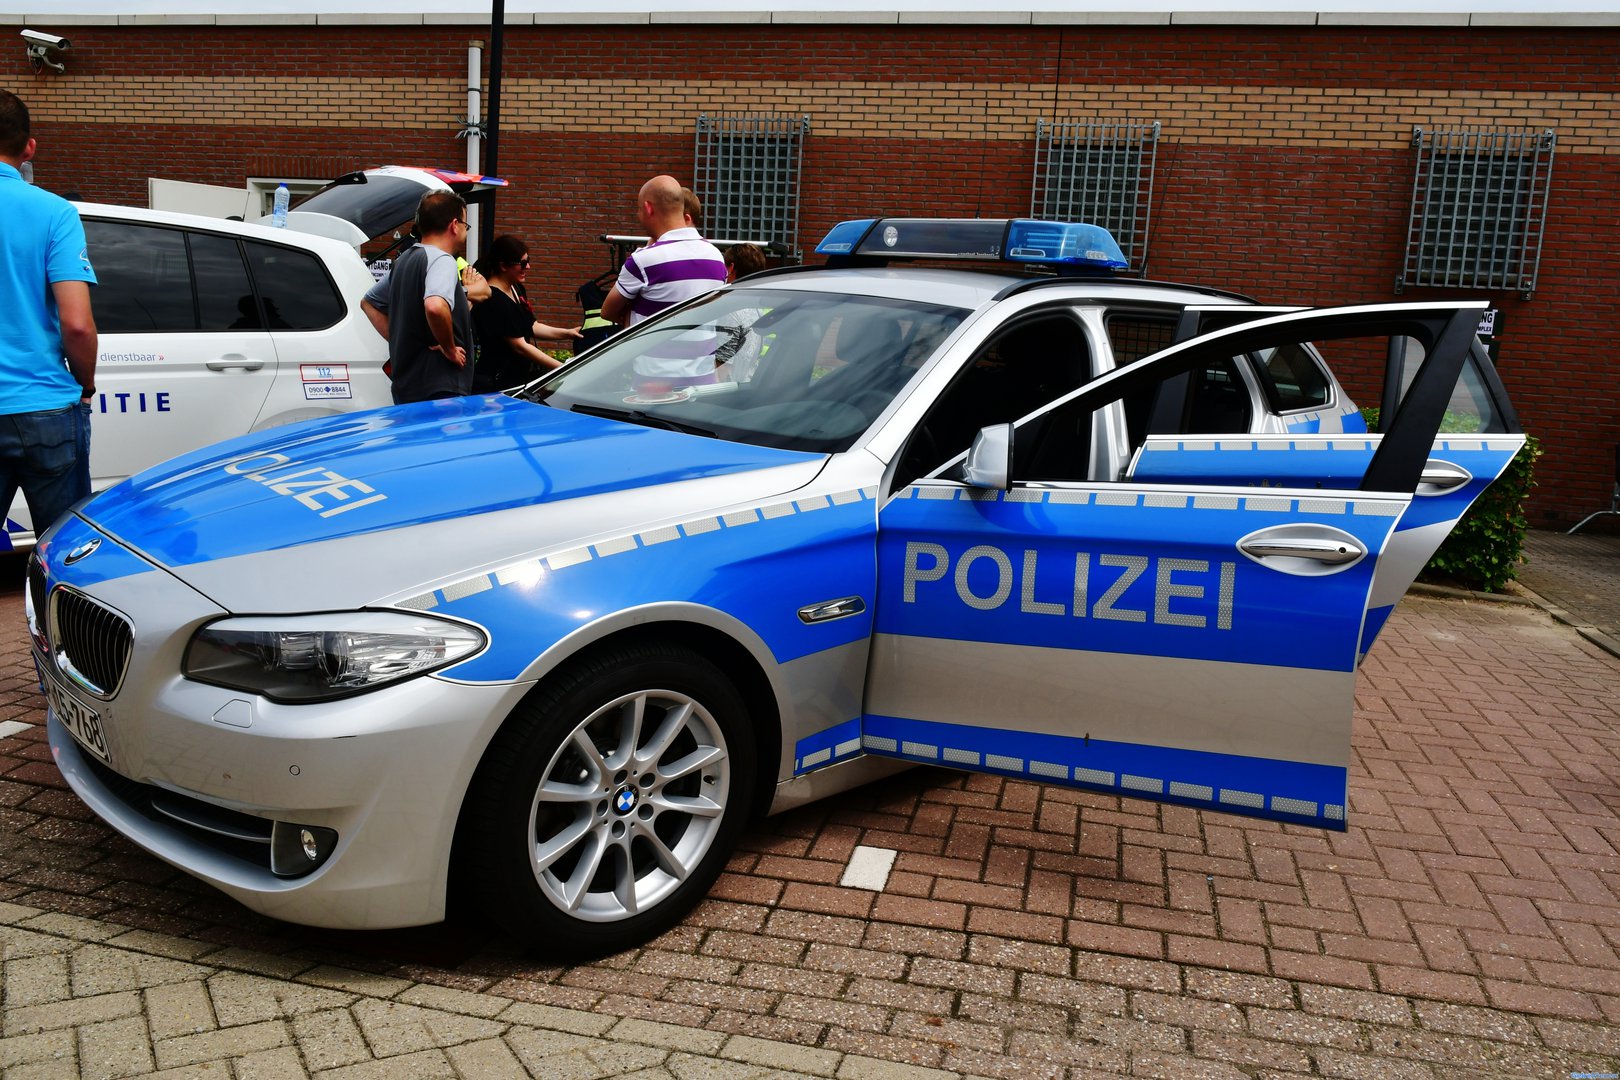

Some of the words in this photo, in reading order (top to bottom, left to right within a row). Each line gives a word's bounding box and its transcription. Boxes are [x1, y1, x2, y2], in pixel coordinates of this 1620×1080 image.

[100, 352, 156, 362] dienstbaar
[317, 367, 332, 376] 112
[903, 541, 1236, 630] POLIZEI
